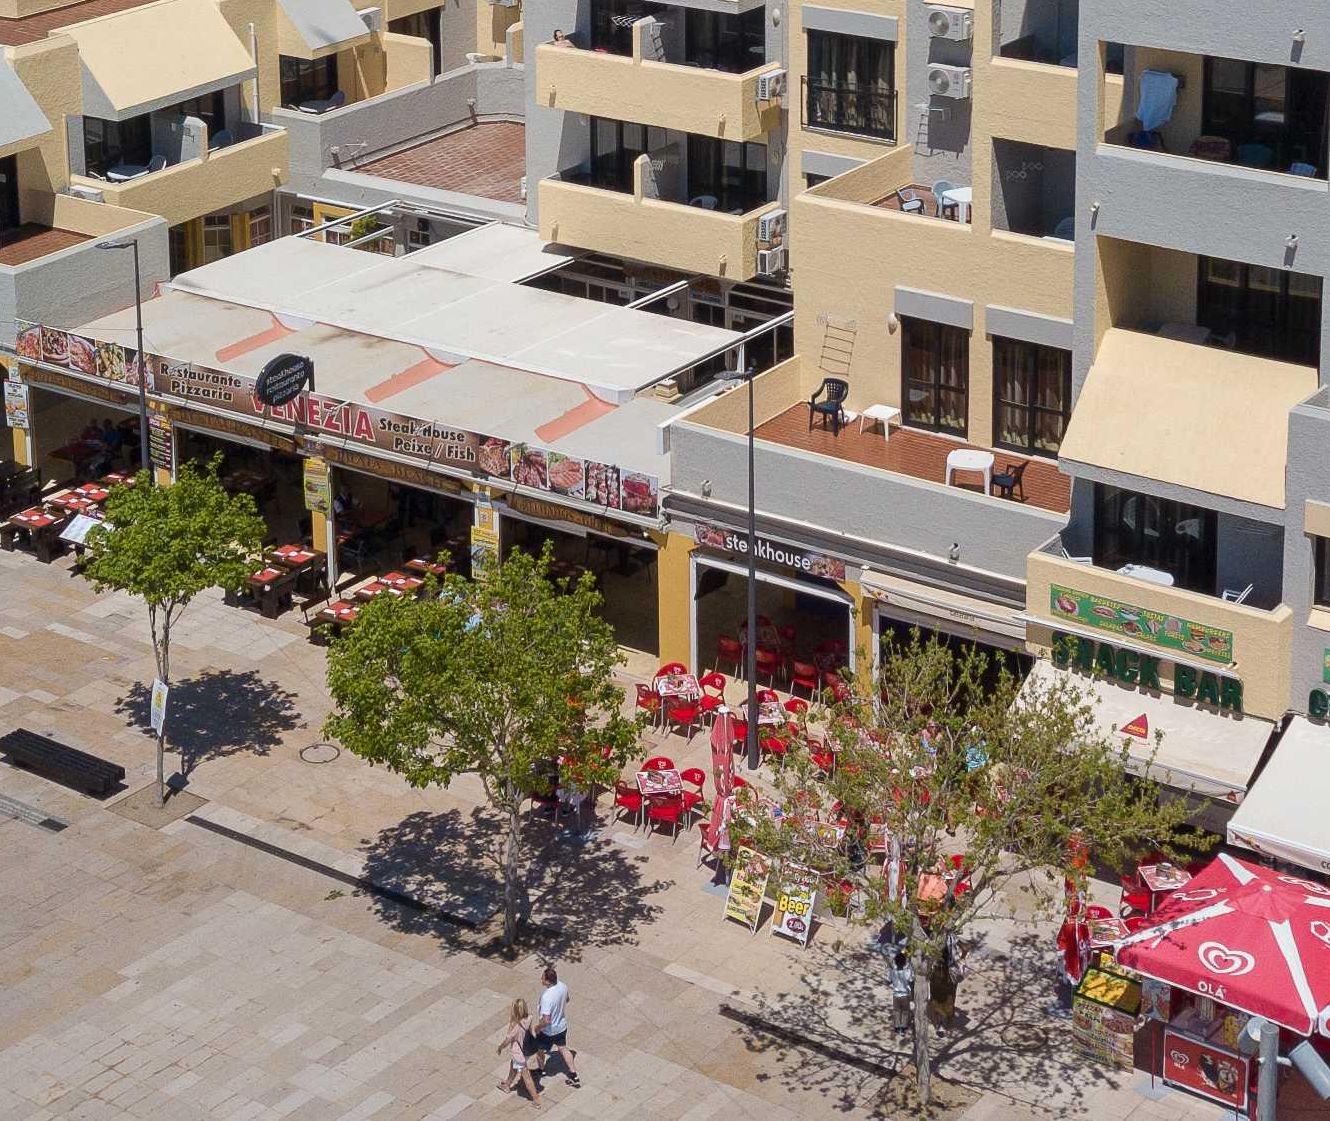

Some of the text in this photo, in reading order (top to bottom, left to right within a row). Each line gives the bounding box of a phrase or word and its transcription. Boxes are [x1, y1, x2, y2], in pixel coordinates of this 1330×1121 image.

[160, 362, 242, 388] Restaurante
[171, 380, 234, 402] Pizzaria
[421, 422, 466, 443] House
[393, 436, 433, 455] Peixe
[446, 445, 476, 462] Fish
[1051, 631, 1244, 713] SNACK BAR
[779, 894, 811, 915] Beer
[1198, 981, 1224, 999] OLÁ
